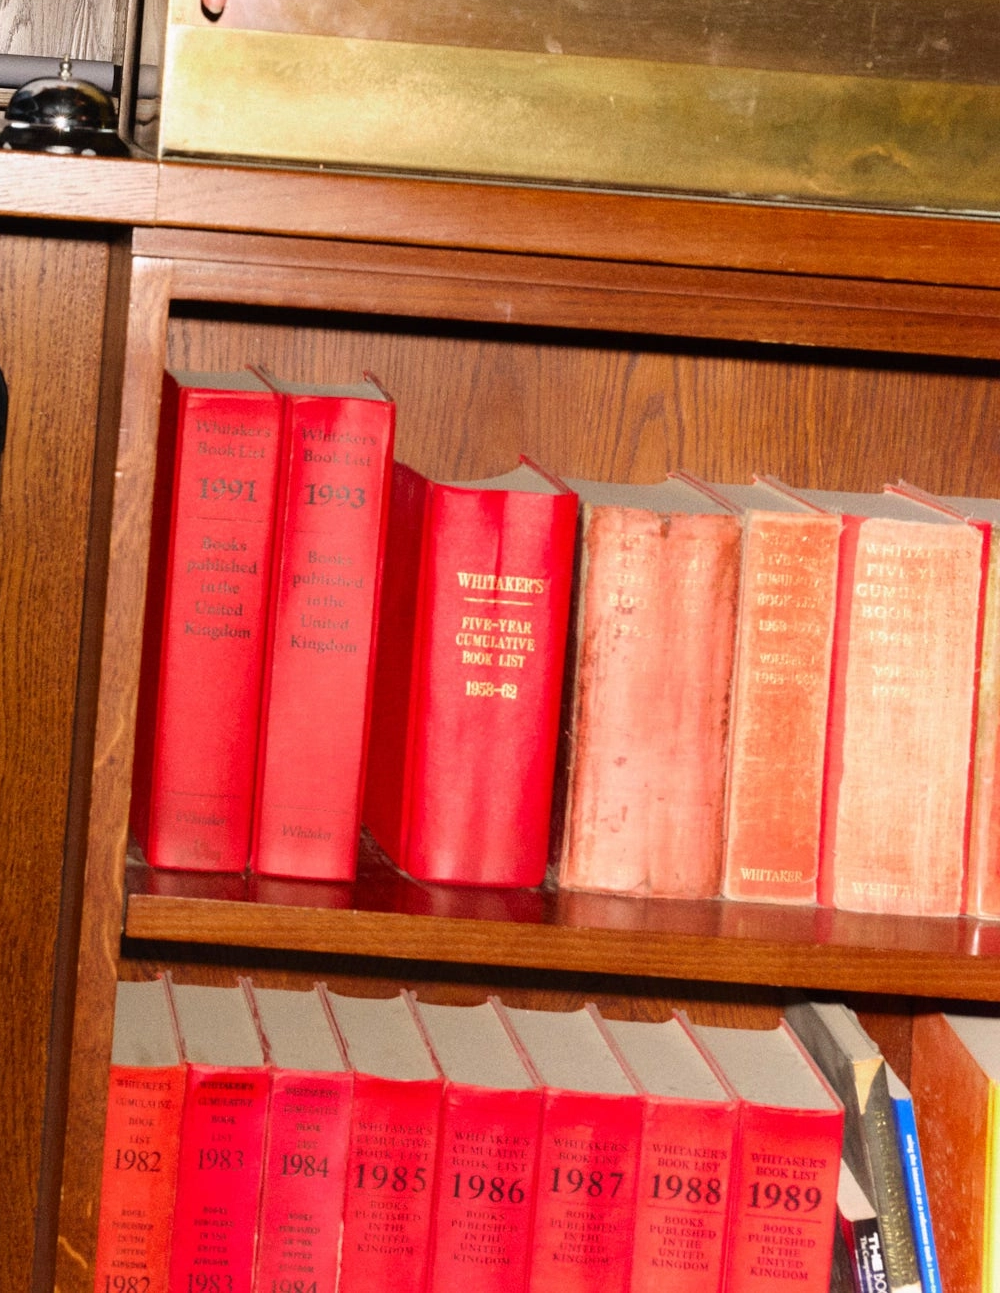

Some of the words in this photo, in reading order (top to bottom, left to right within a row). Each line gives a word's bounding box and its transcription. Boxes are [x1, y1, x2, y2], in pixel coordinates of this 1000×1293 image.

[303, 449, 341, 464] Book
[199, 477, 257, 503] 1991
[304, 483, 367, 509] 1993
[202, 535, 247, 552] Books
[186, 557, 257, 575] published
[307, 550, 353, 566] Books
[201, 581, 215, 593] in
[218, 581, 240, 595] the
[292, 571, 364, 589] published
[457, 572, 545, 594] WHITAKER'S
[195, 600, 243, 617] United
[306, 596, 321, 606] in
[323, 594, 345, 608] the
[184, 621, 251, 641] Kingdom
[301, 613, 350, 631] United
[461, 616, 532, 635] FIVE-YEAR
[290, 634, 357, 653] Kingdom
[455, 632, 535, 652] CUMULATIVE
[461, 650, 493, 666] BOOK
[498, 654, 527, 668] LIST
[740, 867, 803, 883] WHITAKER
[129, 1134, 152, 1145] LIST
[115, 1148, 162, 1173] 1982
[197, 1148, 245, 1171] 1983
[280, 1153, 330, 1179] 1984
[657, 1157, 690, 1169] BOOK
[694, 1161, 721, 1173] LIST
[909, 1153, 917, 1166] the
[354, 1163, 427, 1194] 1985
[756, 1166, 789, 1179] BOOK
[792, 1170, 819, 1181] LIST
[911, 1166, 922, 1196] internet
[452, 1172, 525, 1204] 1986
[551, 1167, 625, 1199] 1987
[648, 1173, 722, 1205] 1988
[747, 1181, 822, 1213] 1989
[664, 1214, 704, 1228] BOOKS
[762, 1224, 803, 1236] BOOKS
[918, 1211, 928, 1245] reference
[649, 1224, 717, 1240] PUBLISHED
[748, 1233, 816, 1248] PUBLISHED
[663, 1236, 676, 1246] IN
[680, 1238, 702, 1249] THE
[761, 1245, 774, 1255] IN
[778, 1247, 801, 1258] THE
[859, 1235, 868, 1250] The
[658, 1247, 705, 1261] UNITED
[868, 1232, 884, 1272] THE
[651, 1258, 709, 1271] KINGDOM
[756, 1256, 804, 1269] UNITED
[187, 1272, 233, 1293] 1983
[750, 1266, 809, 1281] KINGDOM
[104, 1274, 151, 1293] 1982
